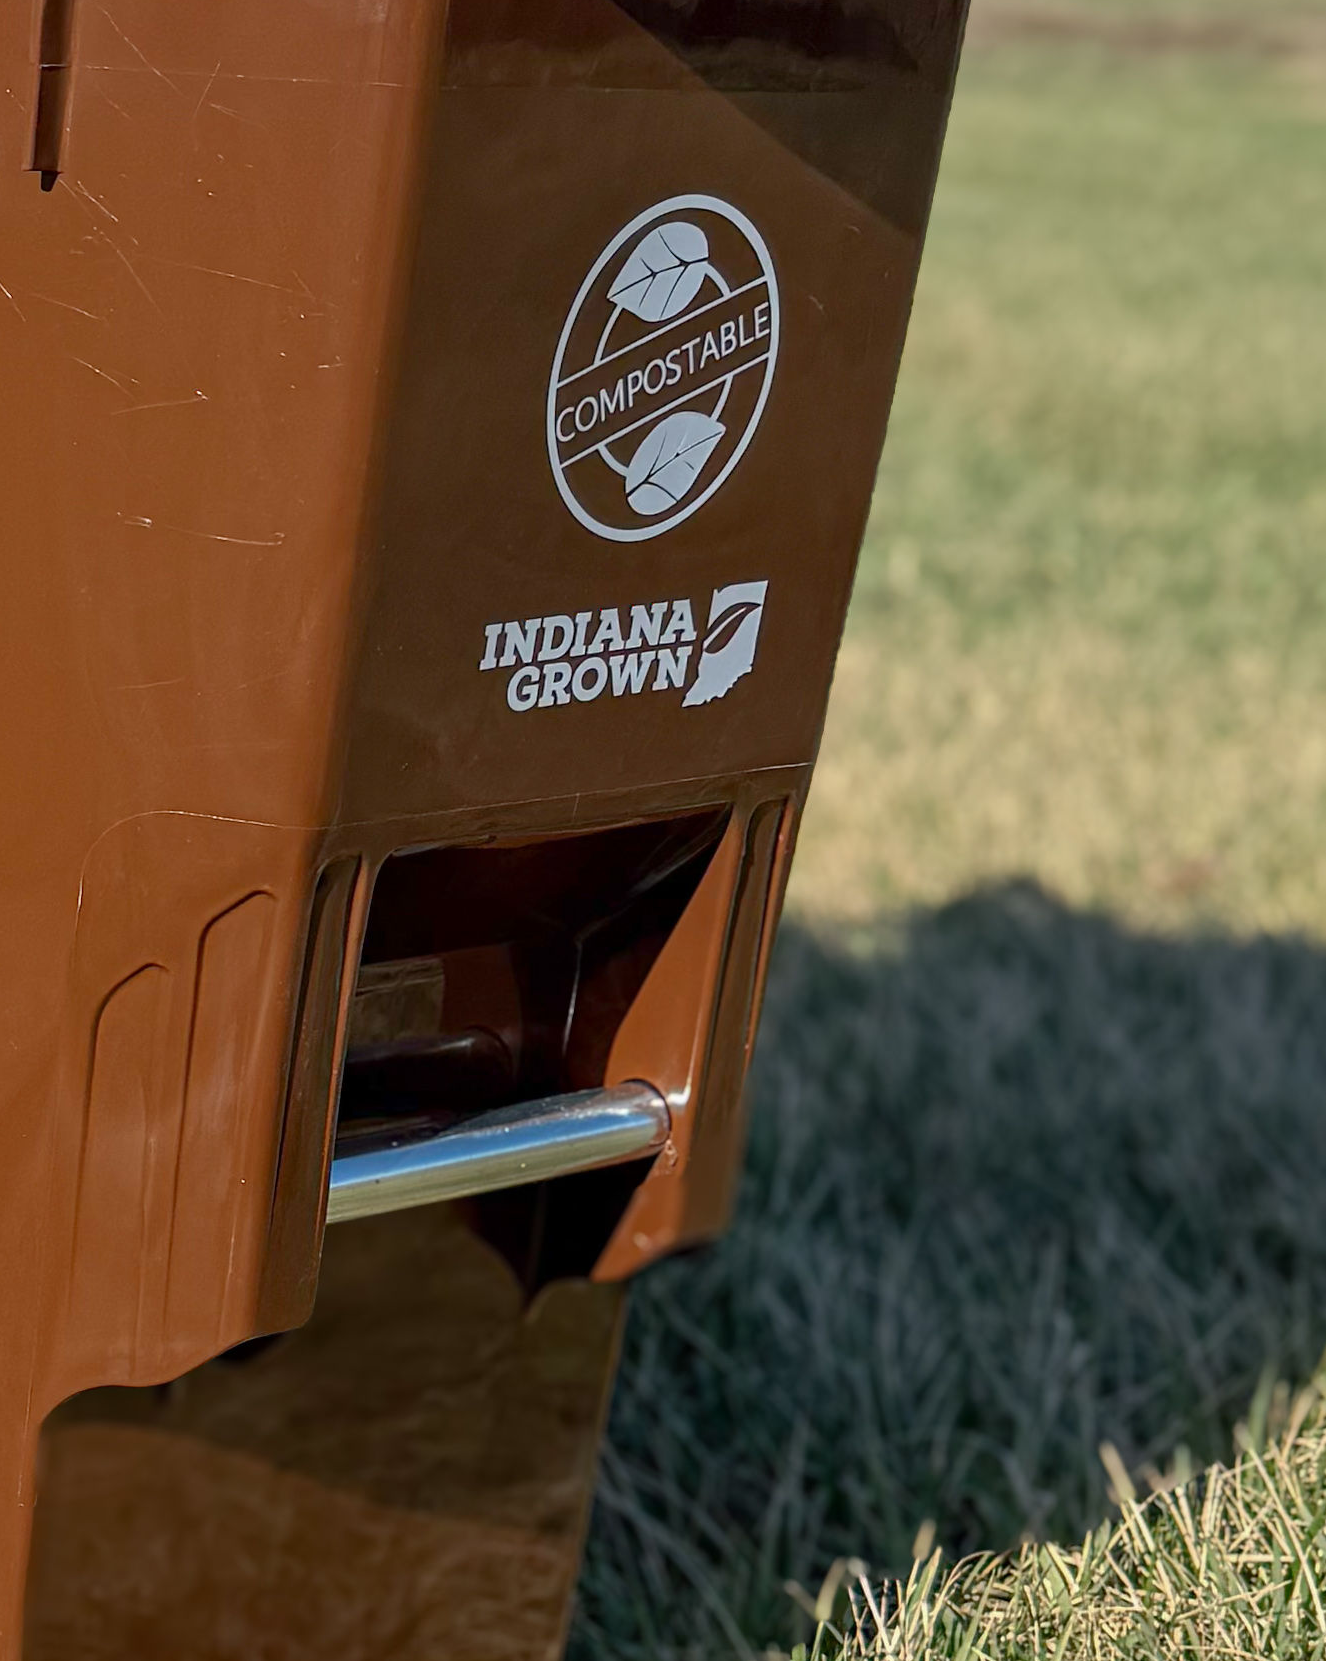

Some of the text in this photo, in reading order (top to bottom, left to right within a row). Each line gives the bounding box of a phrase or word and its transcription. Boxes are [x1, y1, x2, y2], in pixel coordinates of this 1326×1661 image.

[554, 300, 772, 443] COMPOSTABLE
[479, 598, 698, 671] INDIANA
[506, 645, 694, 713] GROWN
